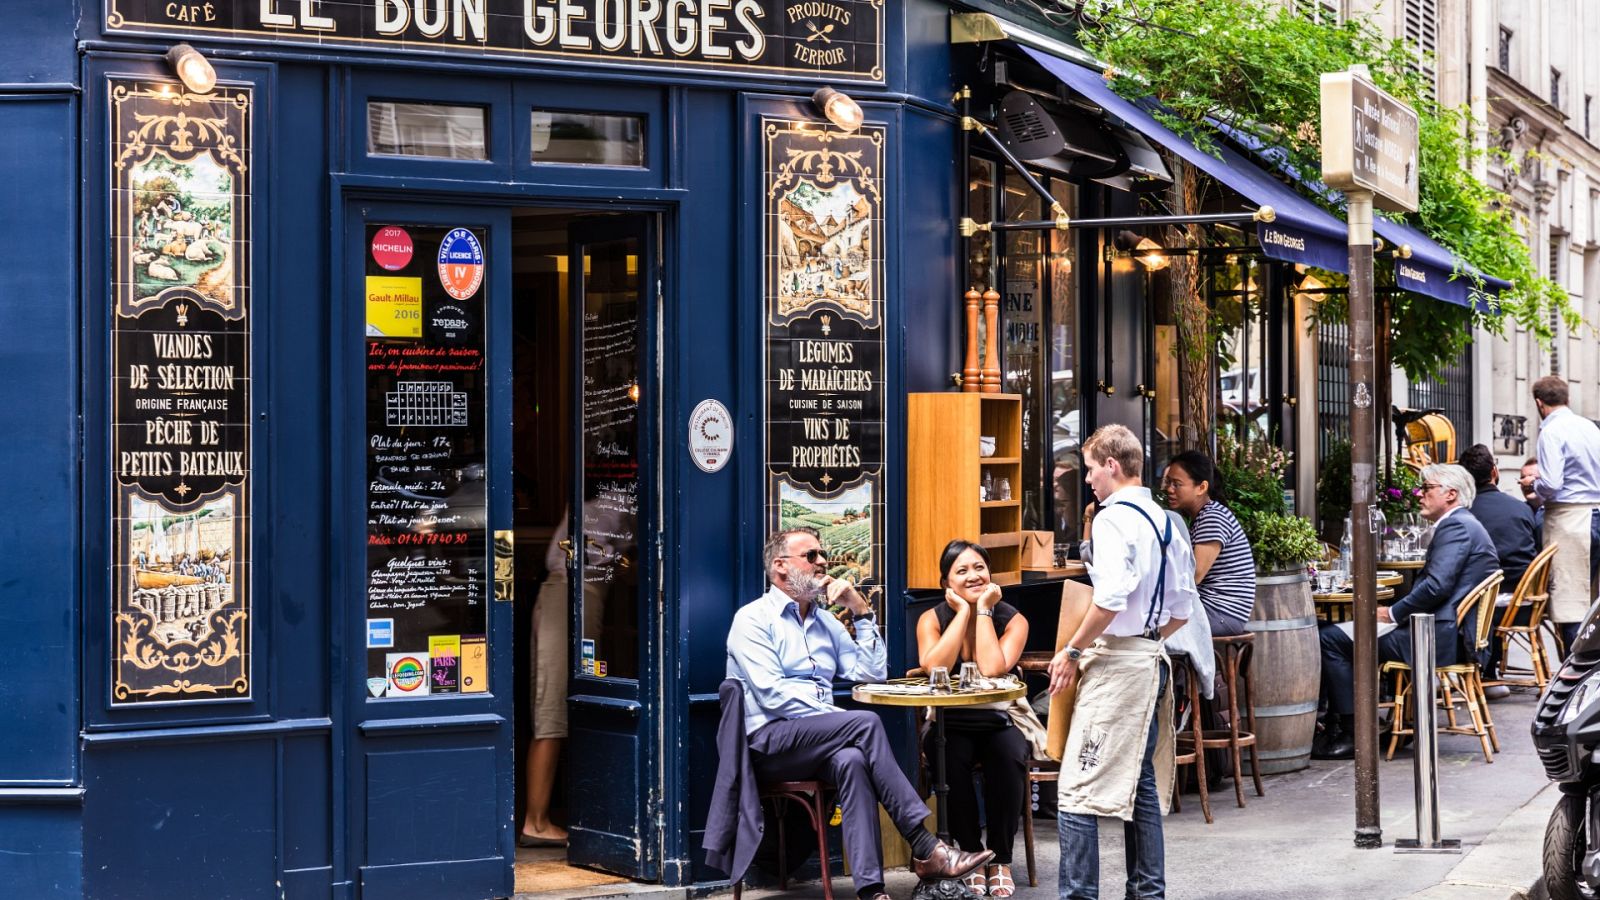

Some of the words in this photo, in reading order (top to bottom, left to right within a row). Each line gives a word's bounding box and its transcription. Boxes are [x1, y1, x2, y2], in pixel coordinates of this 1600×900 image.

[165, 2, 216, 23] CAFÉ
[786, 1, 852, 26] PRODUITS
[375, 0, 488, 42] BON
[523, 0, 766, 61] GEORGES
[793, 43, 847, 66] TERROIR
[384, 229, 401, 237] 2017
[372, 243, 413, 253] MICHELIN
[440, 236, 454, 259] VILLE
[454, 230, 466, 238] DE
[467, 235, 481, 260] PARIS
[454, 267, 467, 278] IV
[369, 294, 391, 302] Gault
[394, 294, 419, 303] Millau
[394, 310, 420, 319] 2016
[153, 333, 213, 359] VIANDES
[388, 348, 400, 356] on
[402, 346, 435, 356] cuisine
[435, 347, 446, 356] de
[799, 340, 854, 363] LÉGUMES
[130, 364, 149, 389] DE
[157, 363, 234, 390] SÉLECTION
[779, 368, 795, 391] DE
[801, 365, 872, 392] MARAÎCHERS
[135, 398, 172, 410] ORIGINE
[177, 399, 228, 413] FRANÇAISE
[789, 399, 818, 409] CUISINE
[822, 400, 833, 409] DE
[837, 400, 862, 410] SAISON
[146, 416, 192, 445] PÊCHE
[200, 420, 219, 445] DE
[803, 418, 830, 440] VINS
[835, 418, 851, 440] DE
[370, 434, 391, 447] Plat
[392, 439, 403, 448] du
[792, 443, 860, 468] PROPRIÉTÉS
[121, 451, 173, 476] PETITS
[180, 451, 244, 476] BATEAUX
[370, 481, 402, 491] Formule
[401, 500, 420, 509] Plat
[420, 501, 429, 509] du
[431, 501, 449, 511] jour
[379, 514, 398, 525] Plat
[454, 533, 468, 544] 30
[387, 556, 425, 572] Quelques
[434, 656, 456, 667] PARIS
